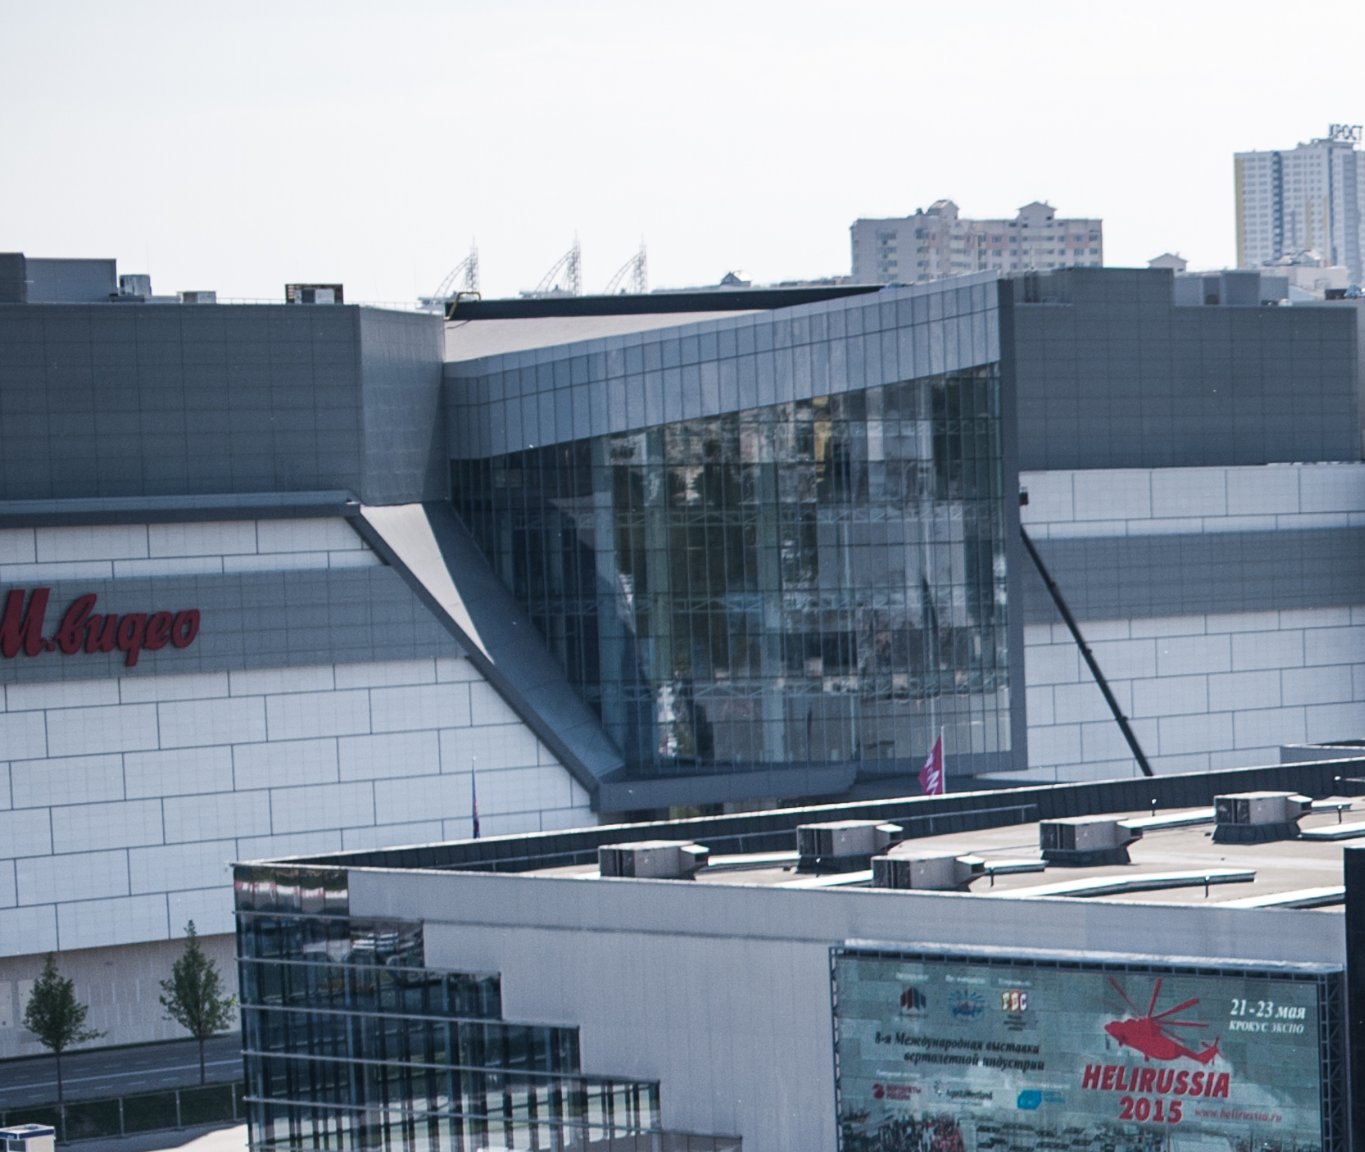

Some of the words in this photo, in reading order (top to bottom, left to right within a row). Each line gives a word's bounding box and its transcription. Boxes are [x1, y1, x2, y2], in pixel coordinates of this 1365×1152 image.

[1275, 1005, 1307, 1020] мая
[1081, 1063, 1230, 1099] HELIRUSSIA
[1118, 1094, 1183, 1124] 2015
